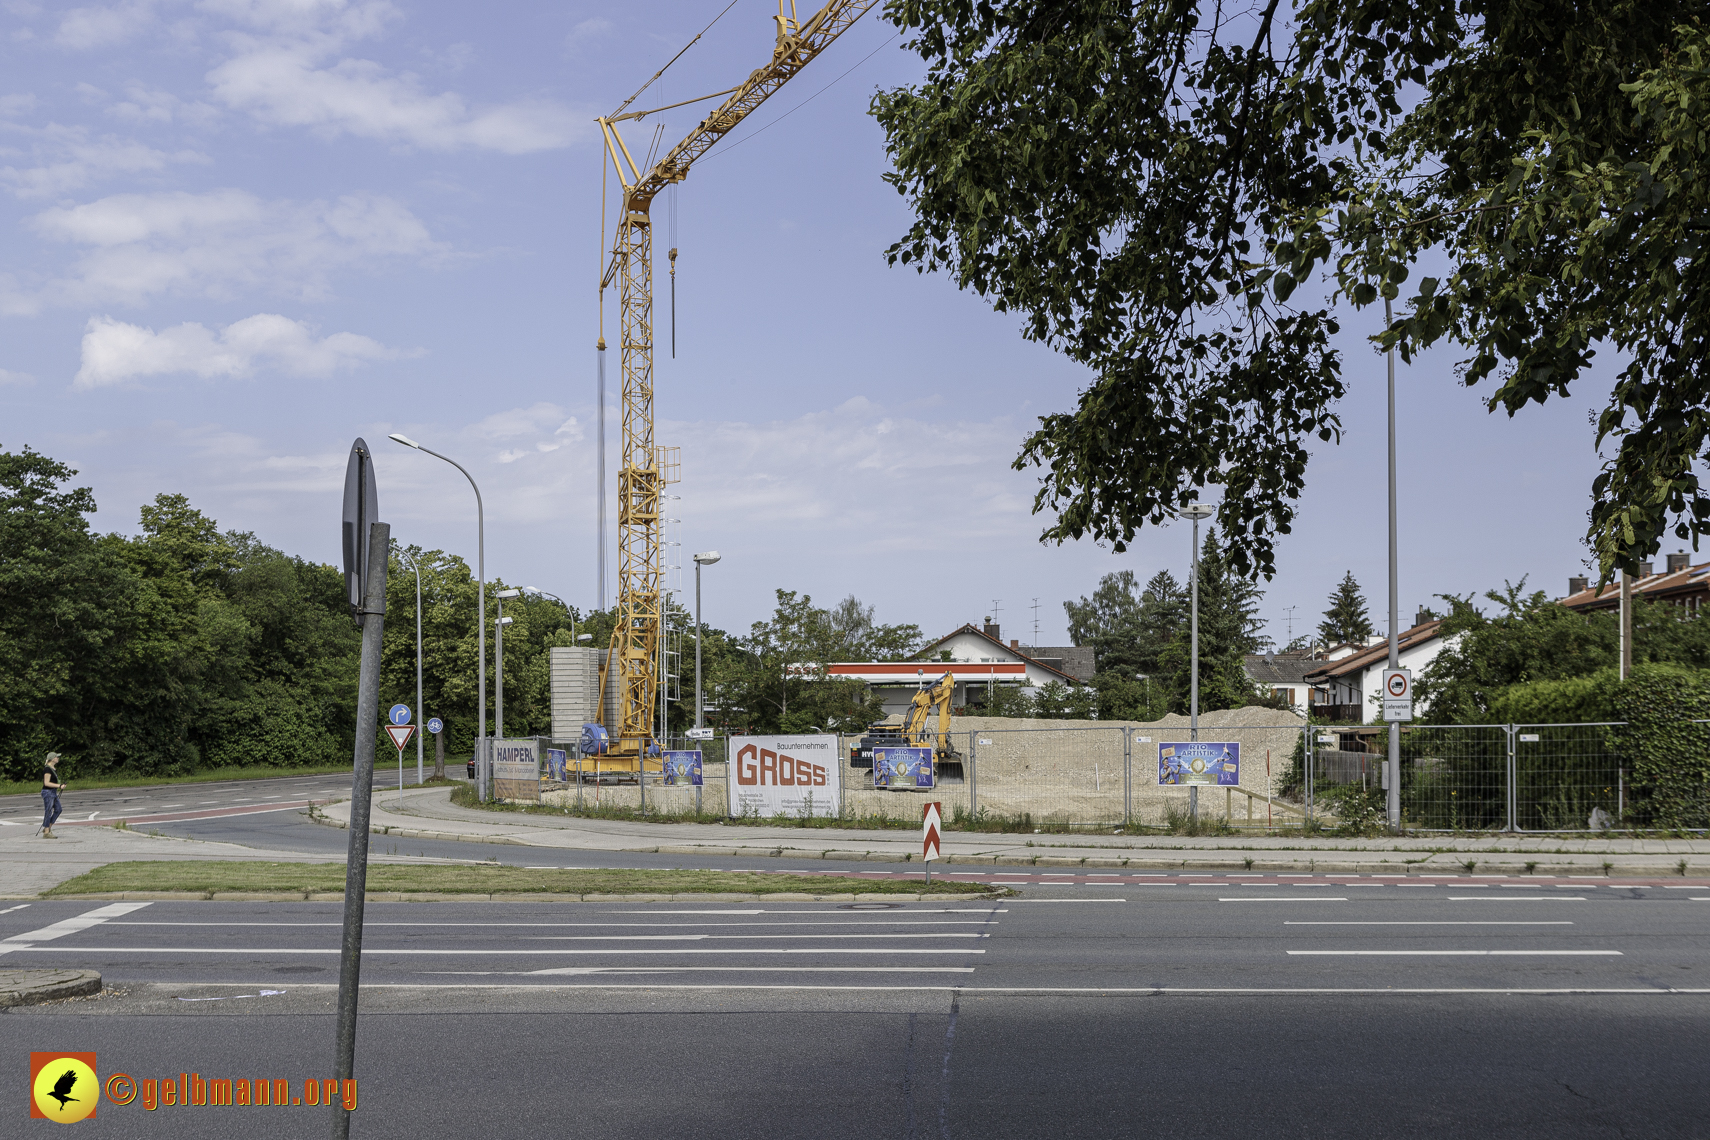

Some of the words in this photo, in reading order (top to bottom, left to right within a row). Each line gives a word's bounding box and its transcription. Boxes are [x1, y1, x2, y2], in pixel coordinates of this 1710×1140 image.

[777, 742, 829, 750] Bauunternehmen
[497, 747, 535, 763] HAMPERL
[737, 743, 826, 786] GROSS
